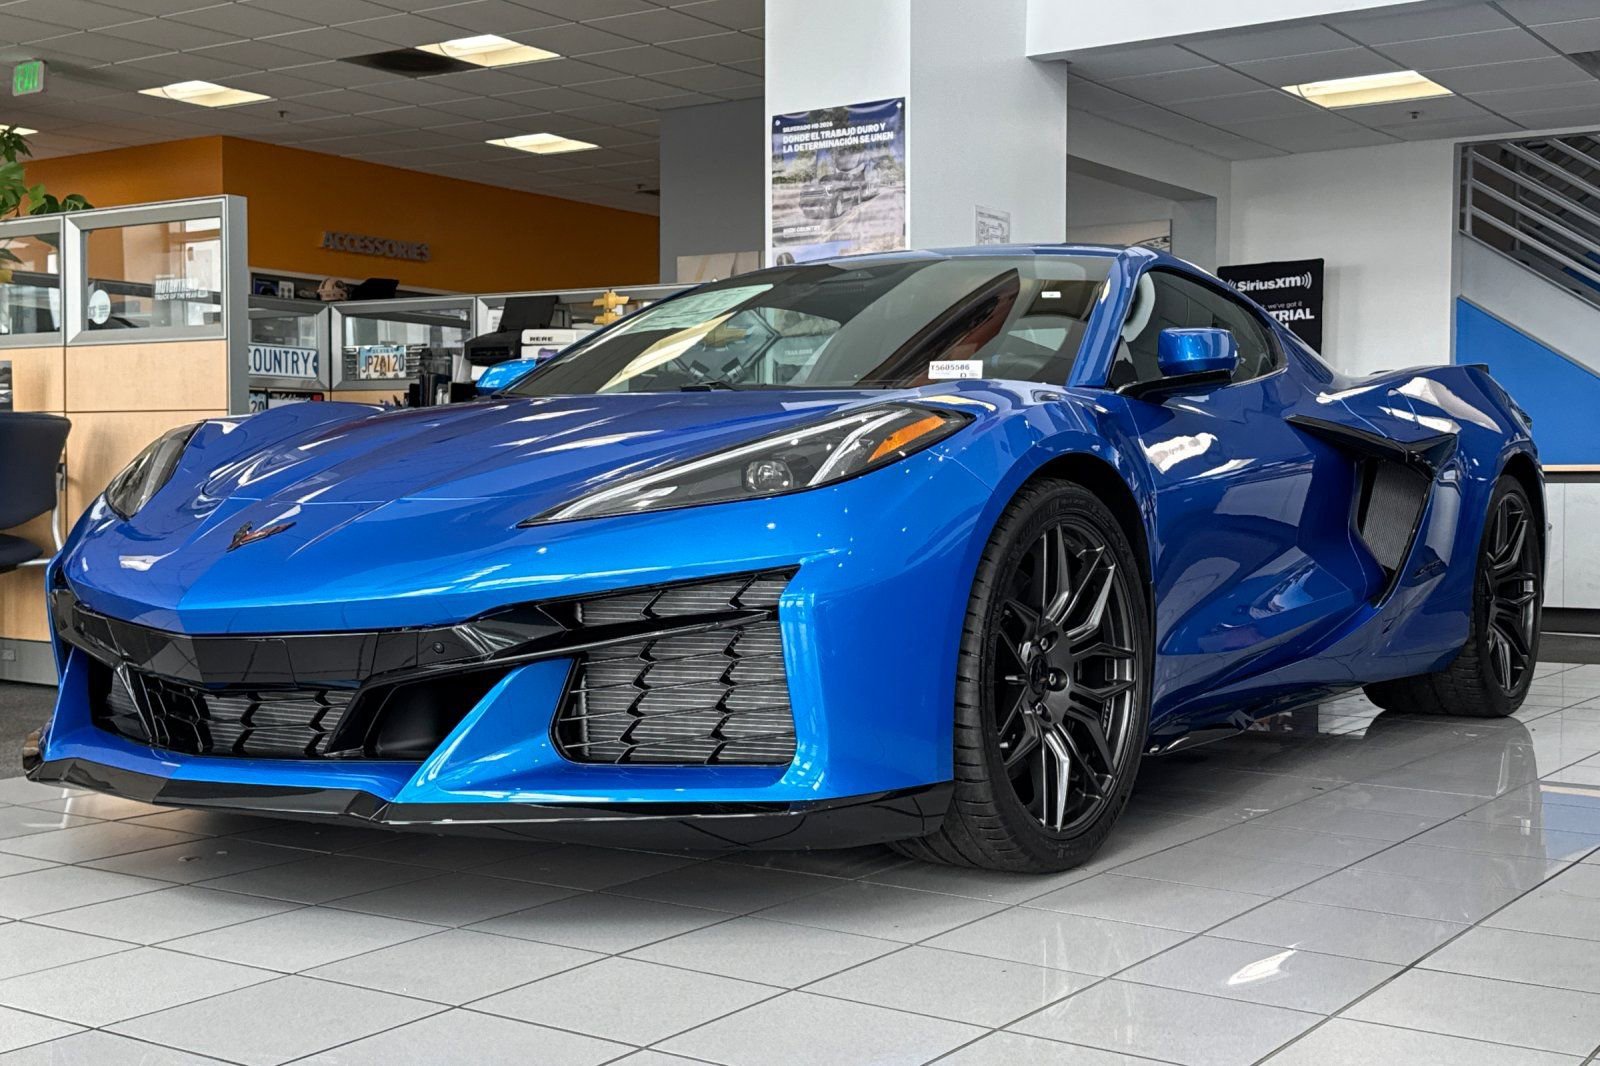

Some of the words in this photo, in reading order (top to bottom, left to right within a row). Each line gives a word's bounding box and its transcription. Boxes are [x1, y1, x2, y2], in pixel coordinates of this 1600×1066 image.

[783, 132, 811, 144] DONDE
[811, 131, 820, 140] EL
[820, 127, 856, 139] TRABAJO
[857, 124, 880, 134] DURO
[880, 123, 887, 132] Y
[783, 144, 794, 153] LA
[794, 137, 858, 151] DETERMINACIÓN
[858, 135, 870, 143] SE
[871, 131, 894, 142] UNEN
[322, 231, 431, 261] ACCESSORIES
[1286, 301, 1297, 310] got
[248, 348, 311, 375] OUNTRY
